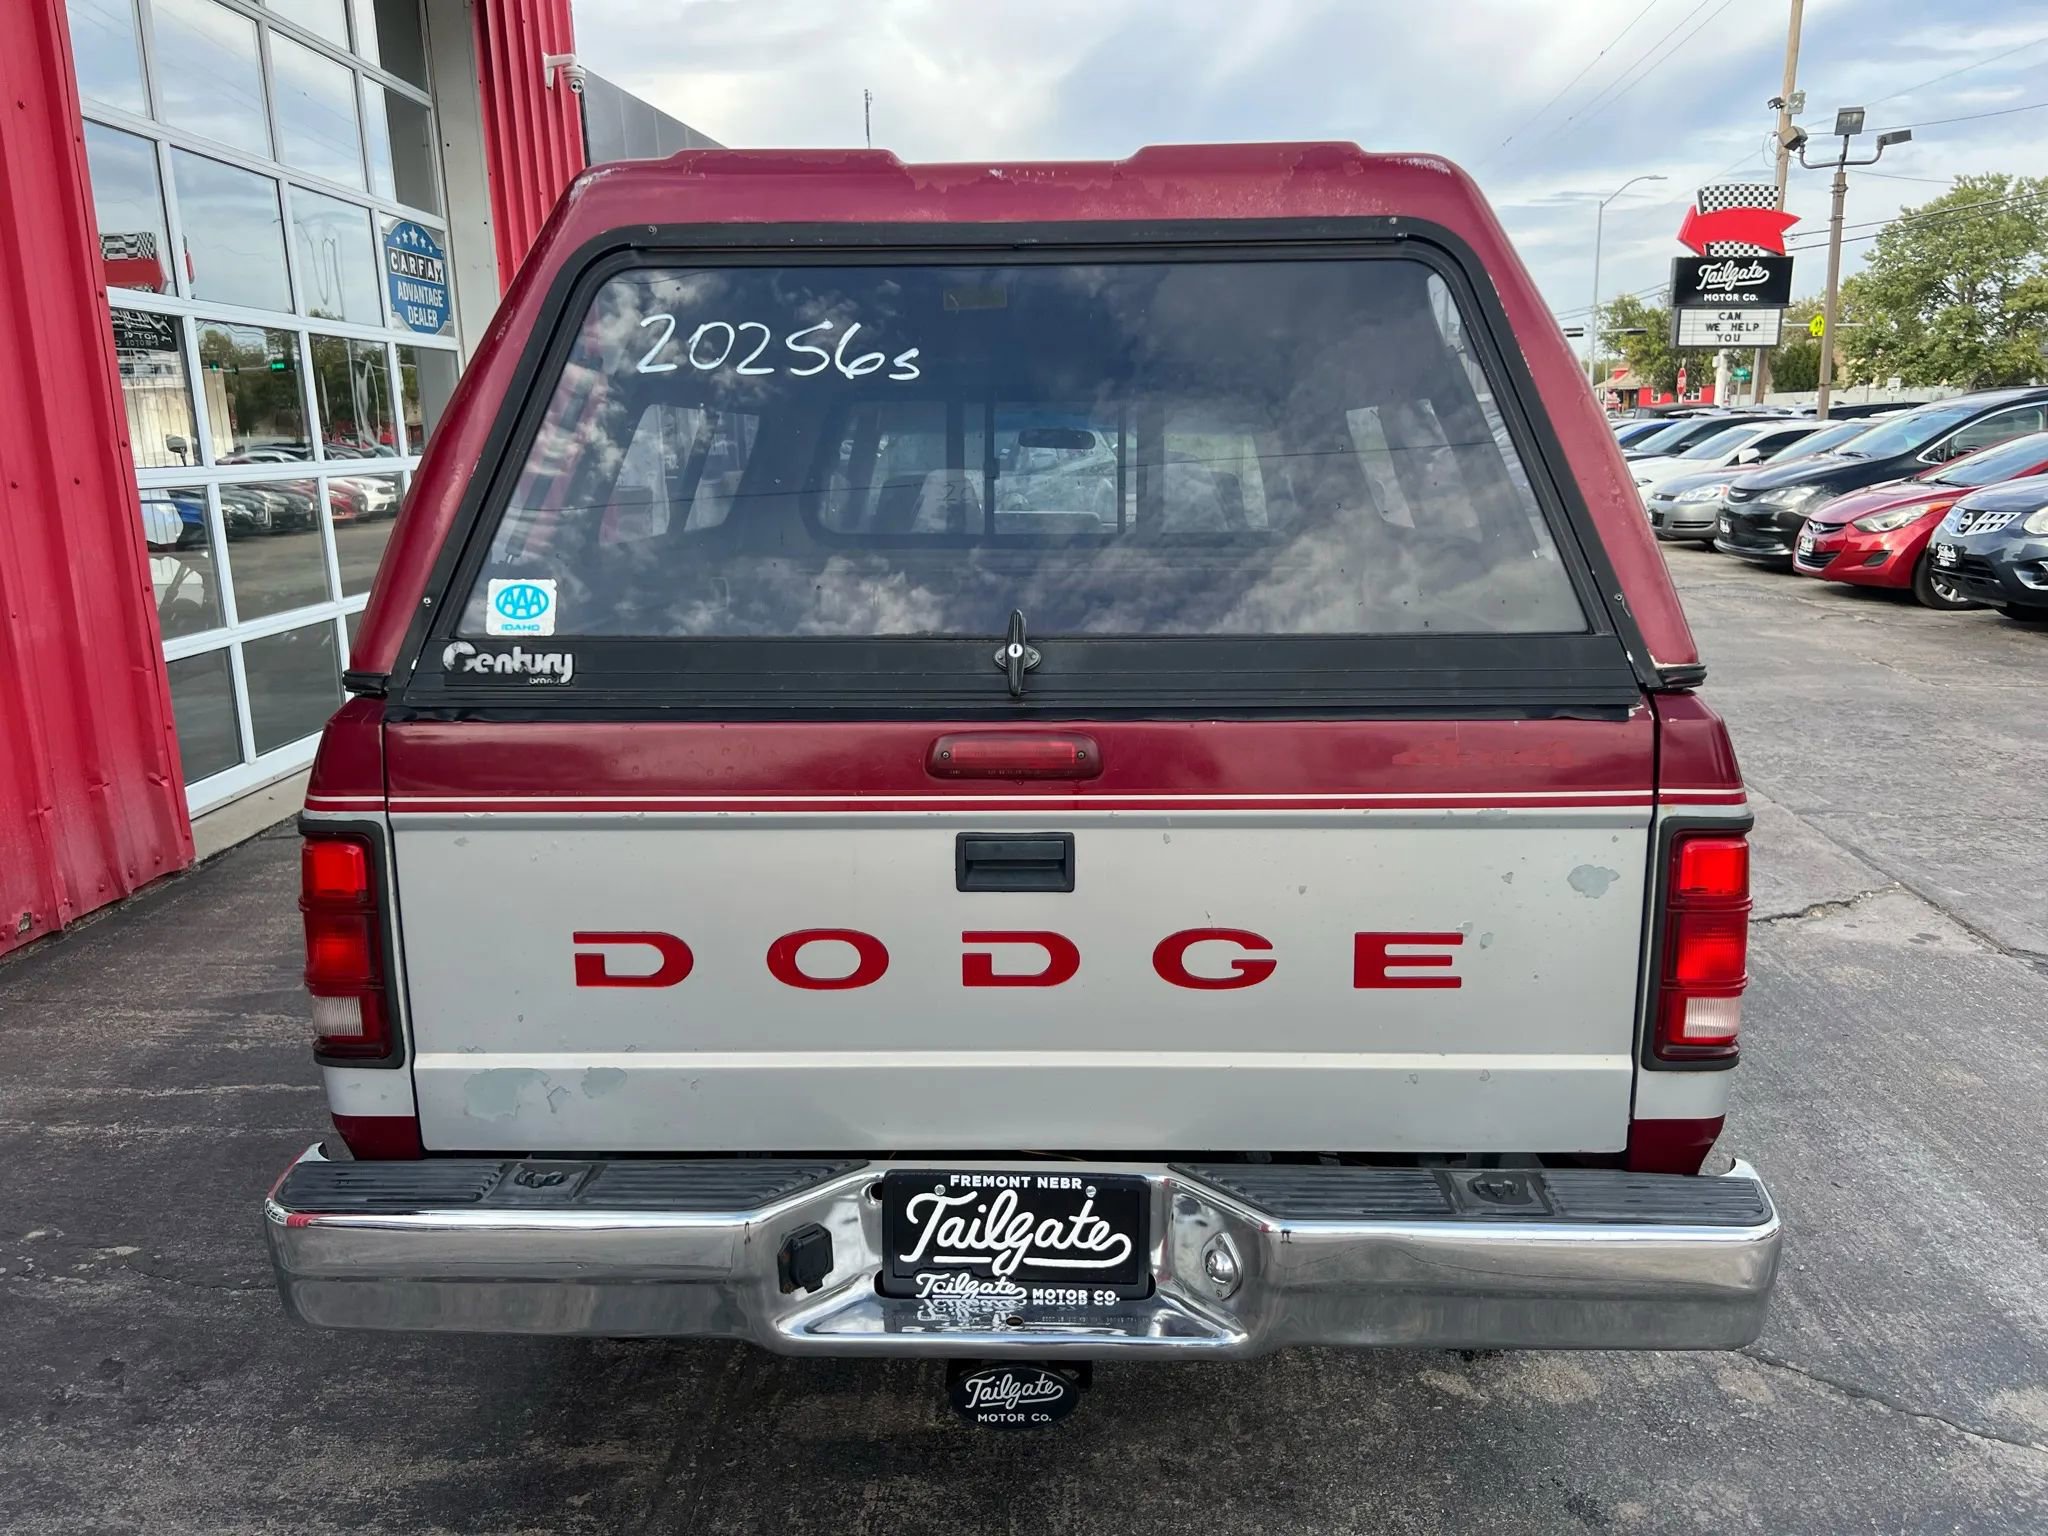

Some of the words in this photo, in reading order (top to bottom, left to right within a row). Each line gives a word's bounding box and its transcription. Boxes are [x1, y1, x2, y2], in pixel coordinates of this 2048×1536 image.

[390, 250, 444, 284] CARFAX
[1695, 260, 1770, 291] Tailgate
[397, 280, 444, 307] ADVANTAGE
[1703, 293, 1739, 302] MOTOR
[407, 306, 439, 328] DEALER
[1705, 323, 1721, 332] WE
[1730, 323, 1760, 332] HELP
[1718, 312, 1742, 321] CAN
[1716, 333, 1741, 342] YOU
[499, 585, 545, 619] AAA
[501, 624, 541, 632] IDAHO
[442, 641, 573, 683] Century
[572, 927, 1464, 991] DODGE
[949, 1174, 1031, 1189] FREMONT
[1037, 1176, 1082, 1190] NEBR
[899, 1189, 1132, 1276] Tailgate
[915, 1272, 1027, 1300] Tailgate
[1032, 1289, 1087, 1301] MOTOR
[1093, 1290, 1120, 1302] CO.
[965, 1373, 1064, 1410] Tailgate
[977, 1413, 1025, 1423] MOTOR
